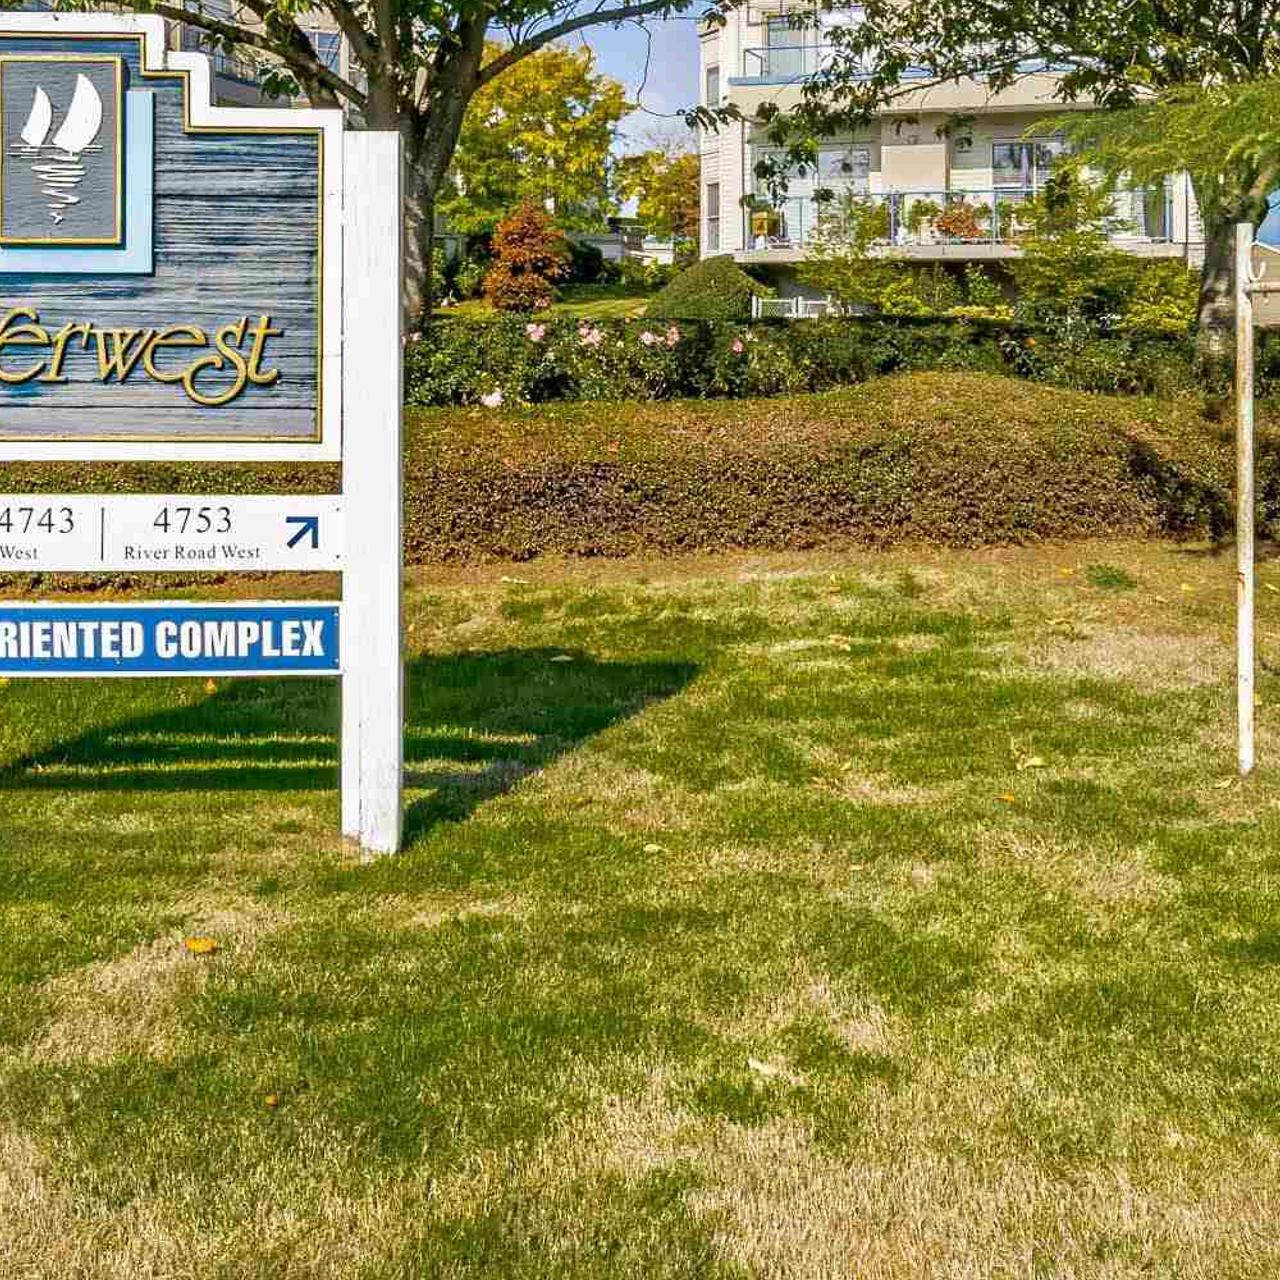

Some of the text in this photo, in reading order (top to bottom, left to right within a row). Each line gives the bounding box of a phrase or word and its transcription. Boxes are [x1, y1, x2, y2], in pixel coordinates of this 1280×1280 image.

[152, 506, 232, 534] 4753
[123, 544, 261, 561] River Road West
[154, 620, 326, 659] COMPLEX
